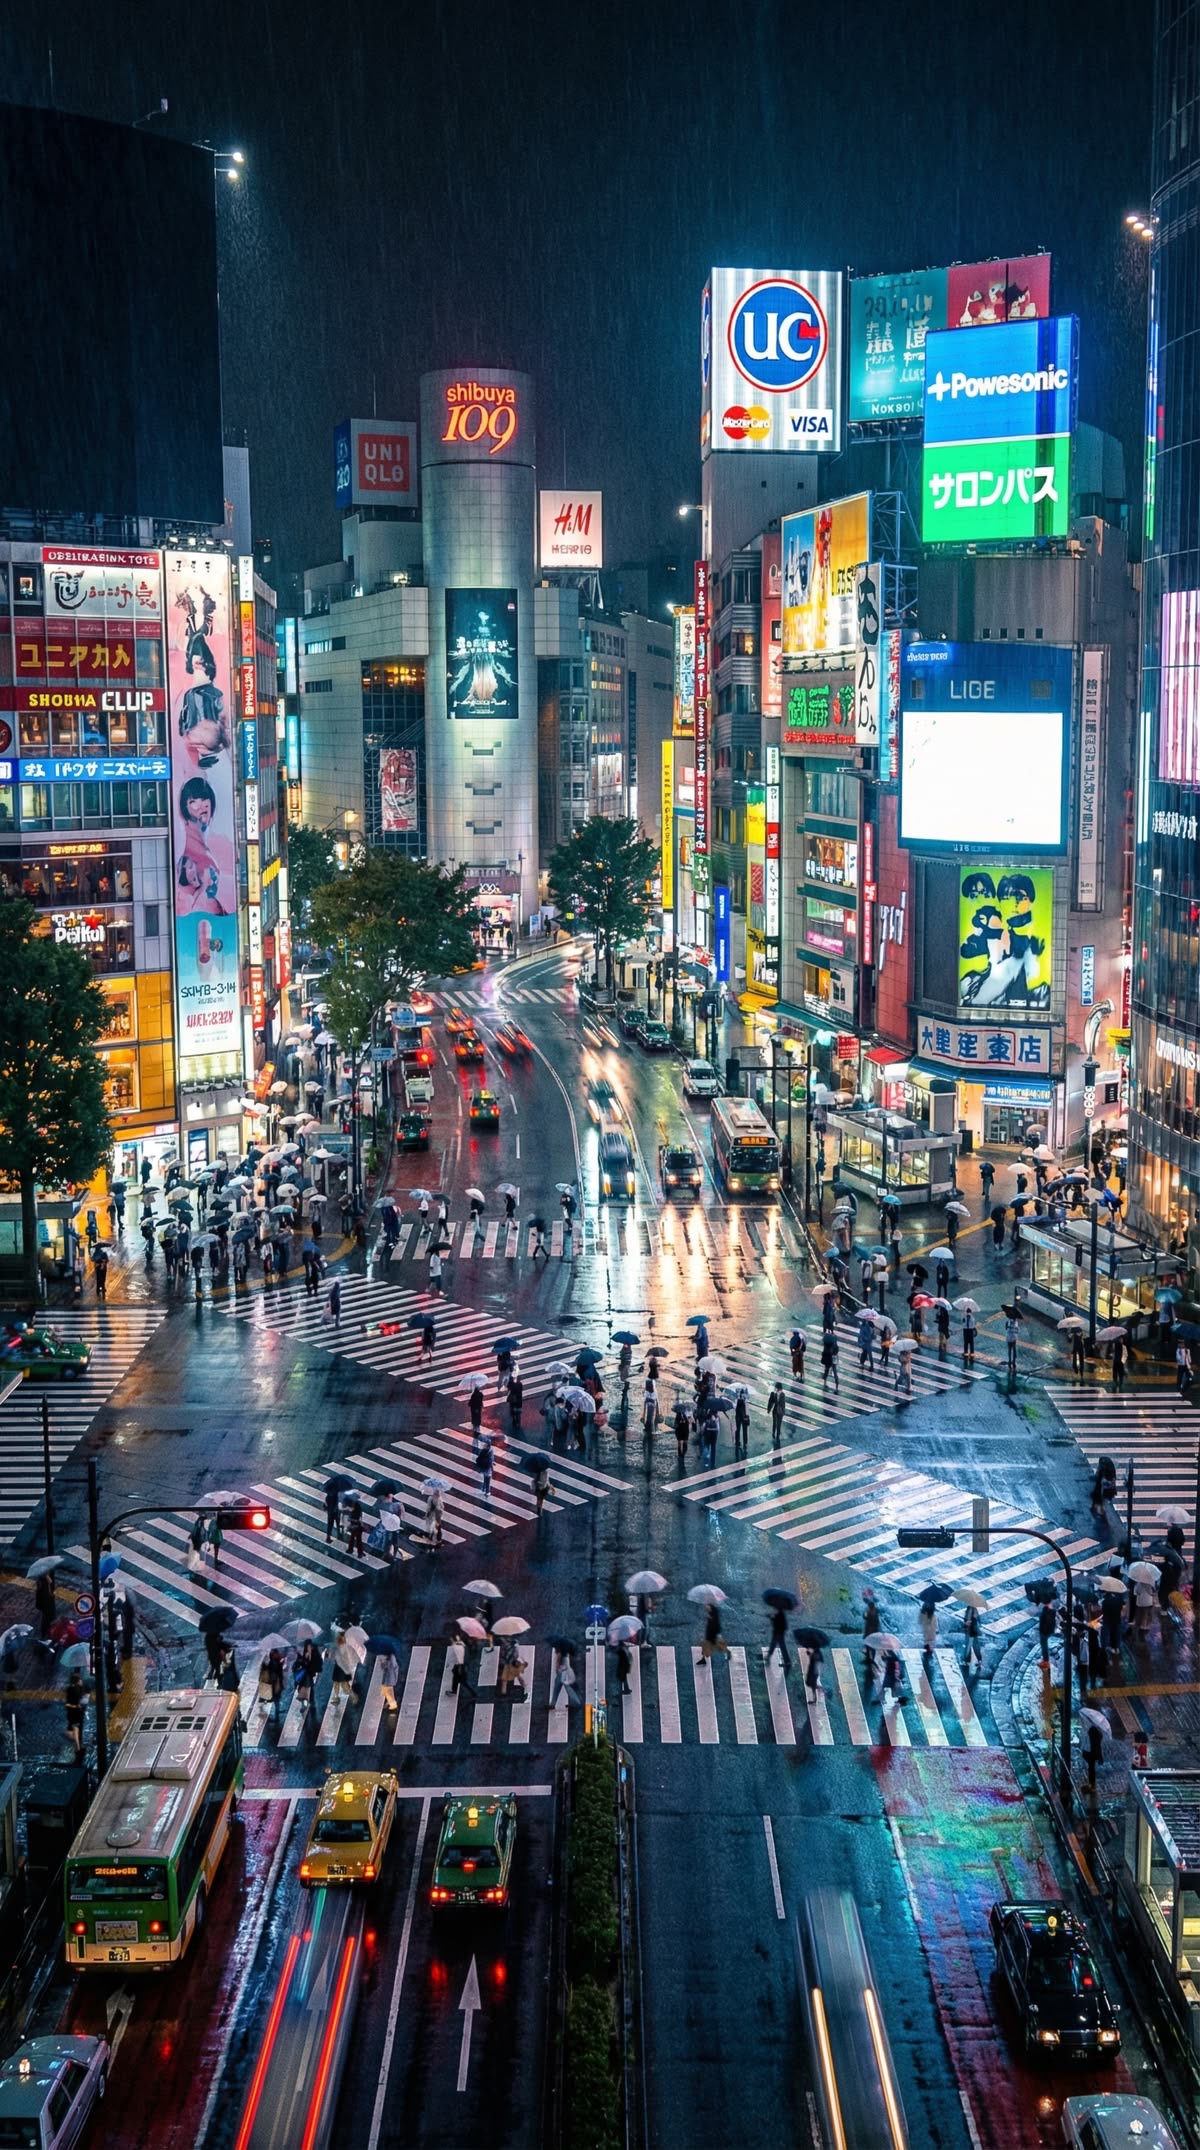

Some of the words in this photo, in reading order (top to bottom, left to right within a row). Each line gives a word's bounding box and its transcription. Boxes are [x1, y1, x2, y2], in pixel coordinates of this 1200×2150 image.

[446, 382, 516, 406] shibuya
[441, 403, 517, 455] 109
[790, 416, 829, 433] VISA
[363, 442, 402, 462] UNI
[928, 466, 1059, 511] サロンパス
